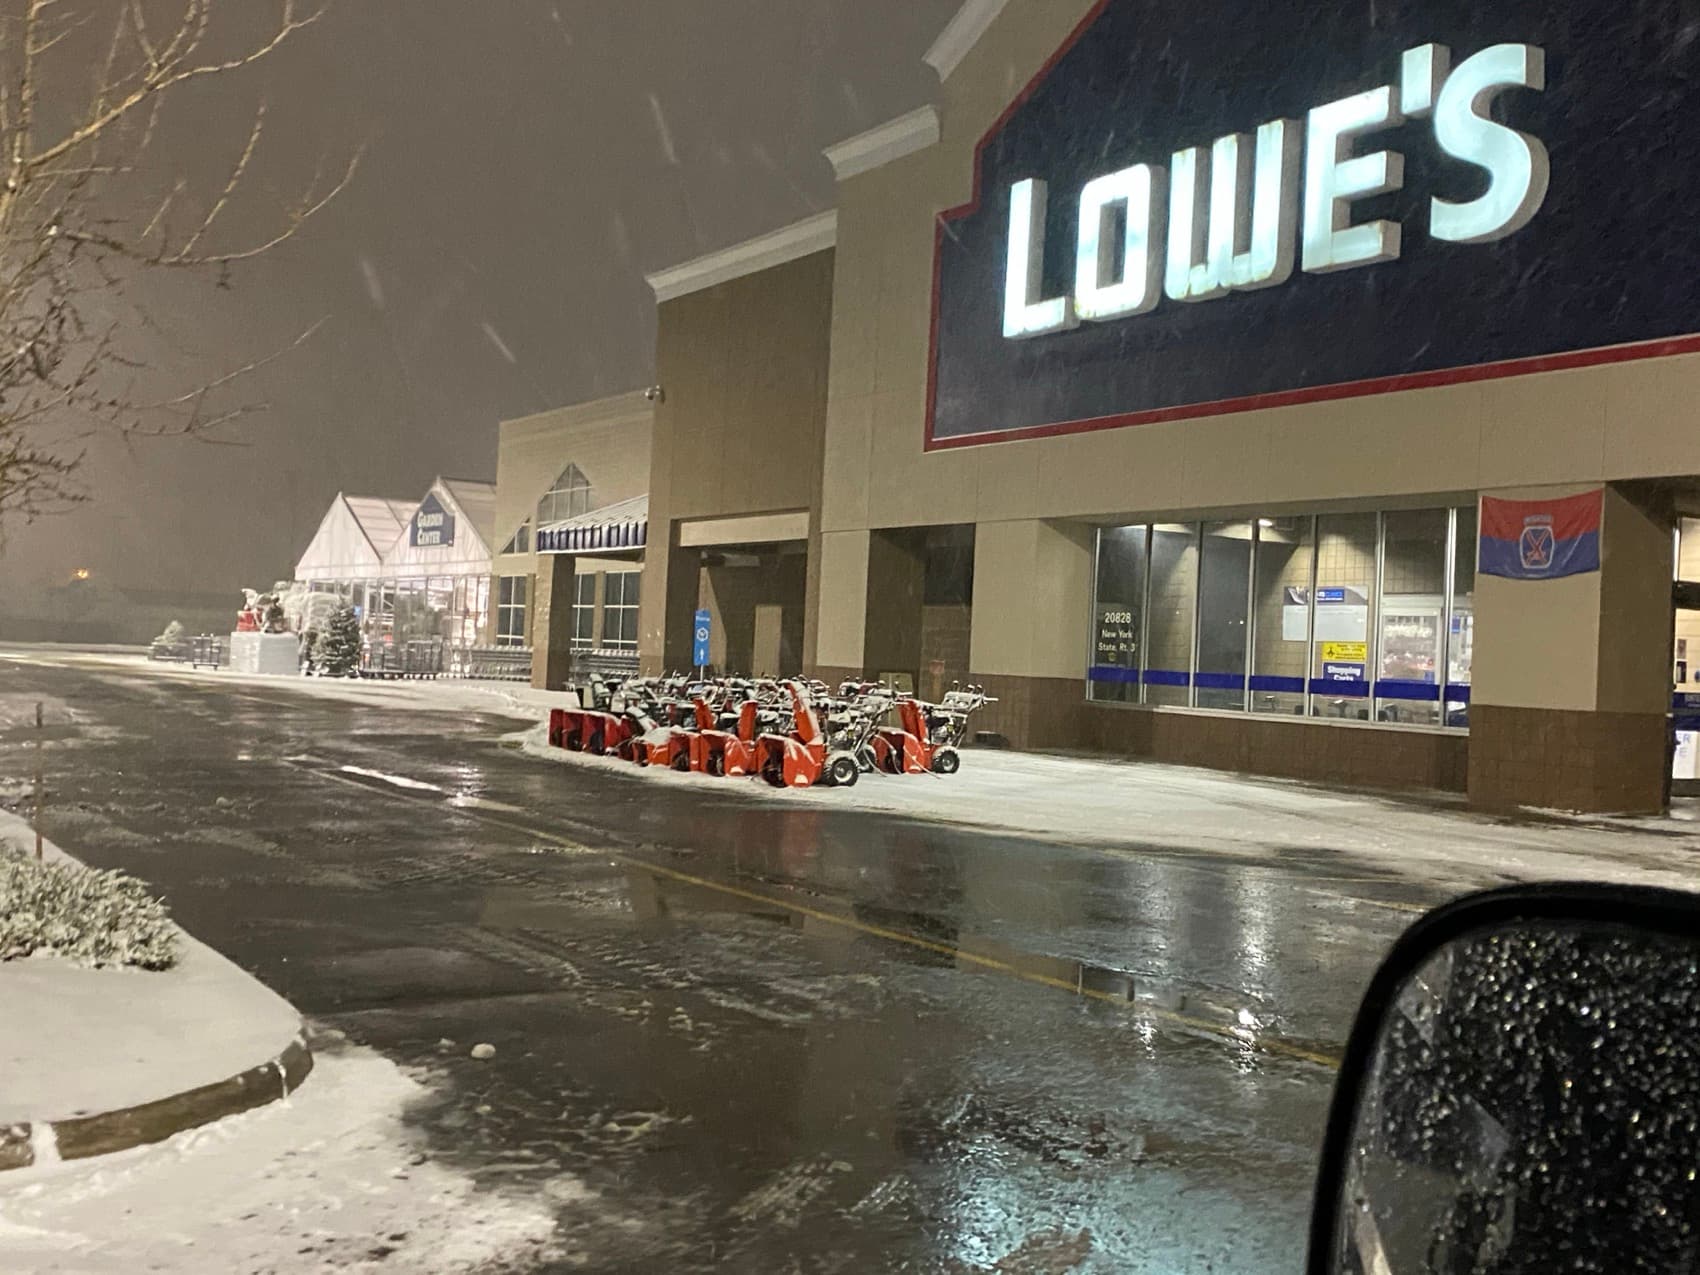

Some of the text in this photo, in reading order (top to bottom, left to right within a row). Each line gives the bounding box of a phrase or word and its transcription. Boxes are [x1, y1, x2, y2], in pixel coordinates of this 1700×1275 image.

[1003, 42, 1550, 341] LOWE'S
[1104, 611, 1132, 624] 20828
[1101, 628, 1133, 639] New York
[1130, 642, 1136, 653] 3
